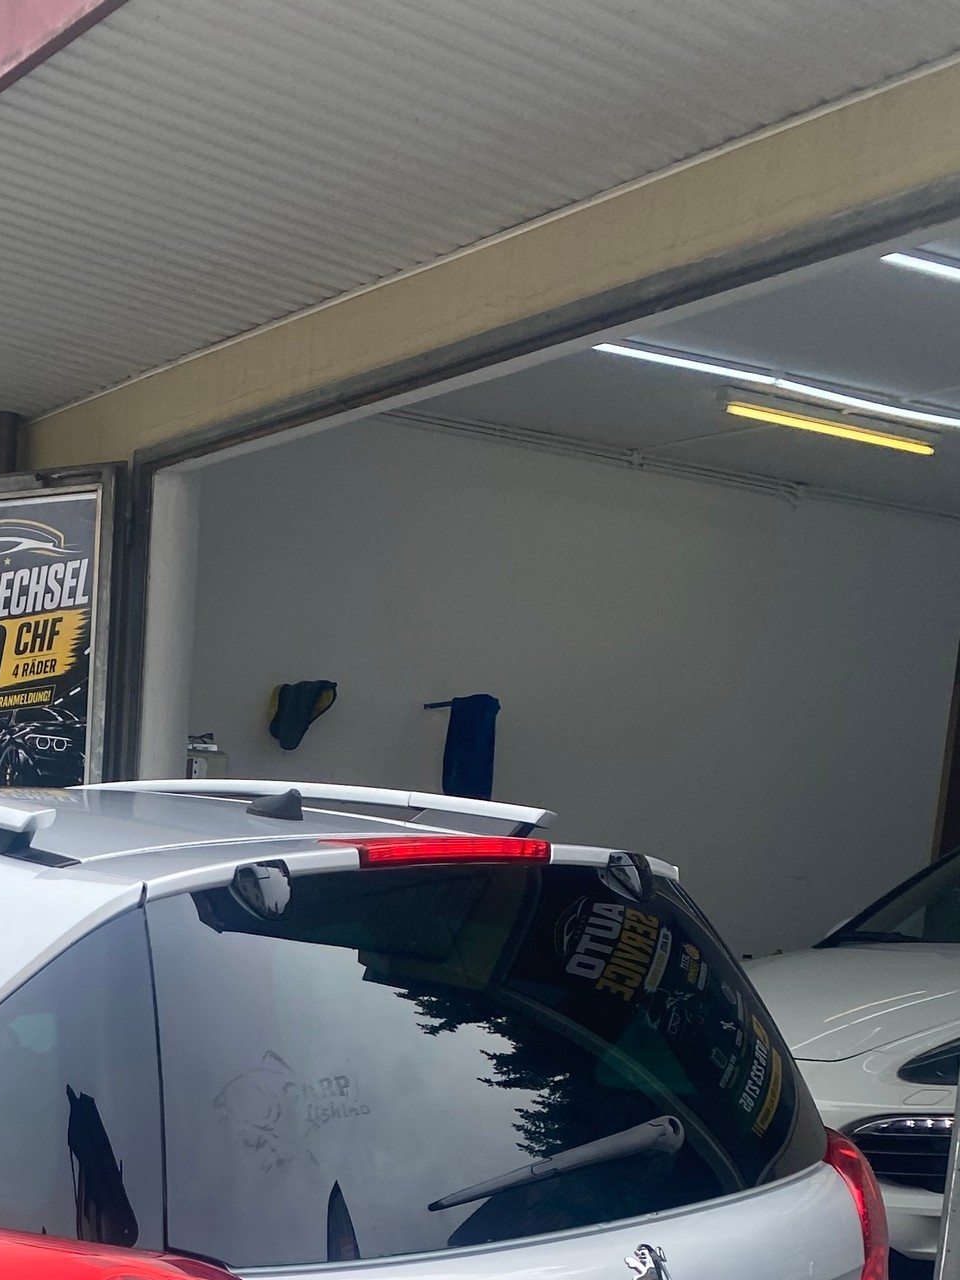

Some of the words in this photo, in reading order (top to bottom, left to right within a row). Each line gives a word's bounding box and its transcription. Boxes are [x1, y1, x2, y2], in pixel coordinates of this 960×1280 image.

[14, 617, 63, 656] CHF
[12, 666, 19, 679] 4
[22, 658, 57, 677] RÄDER
